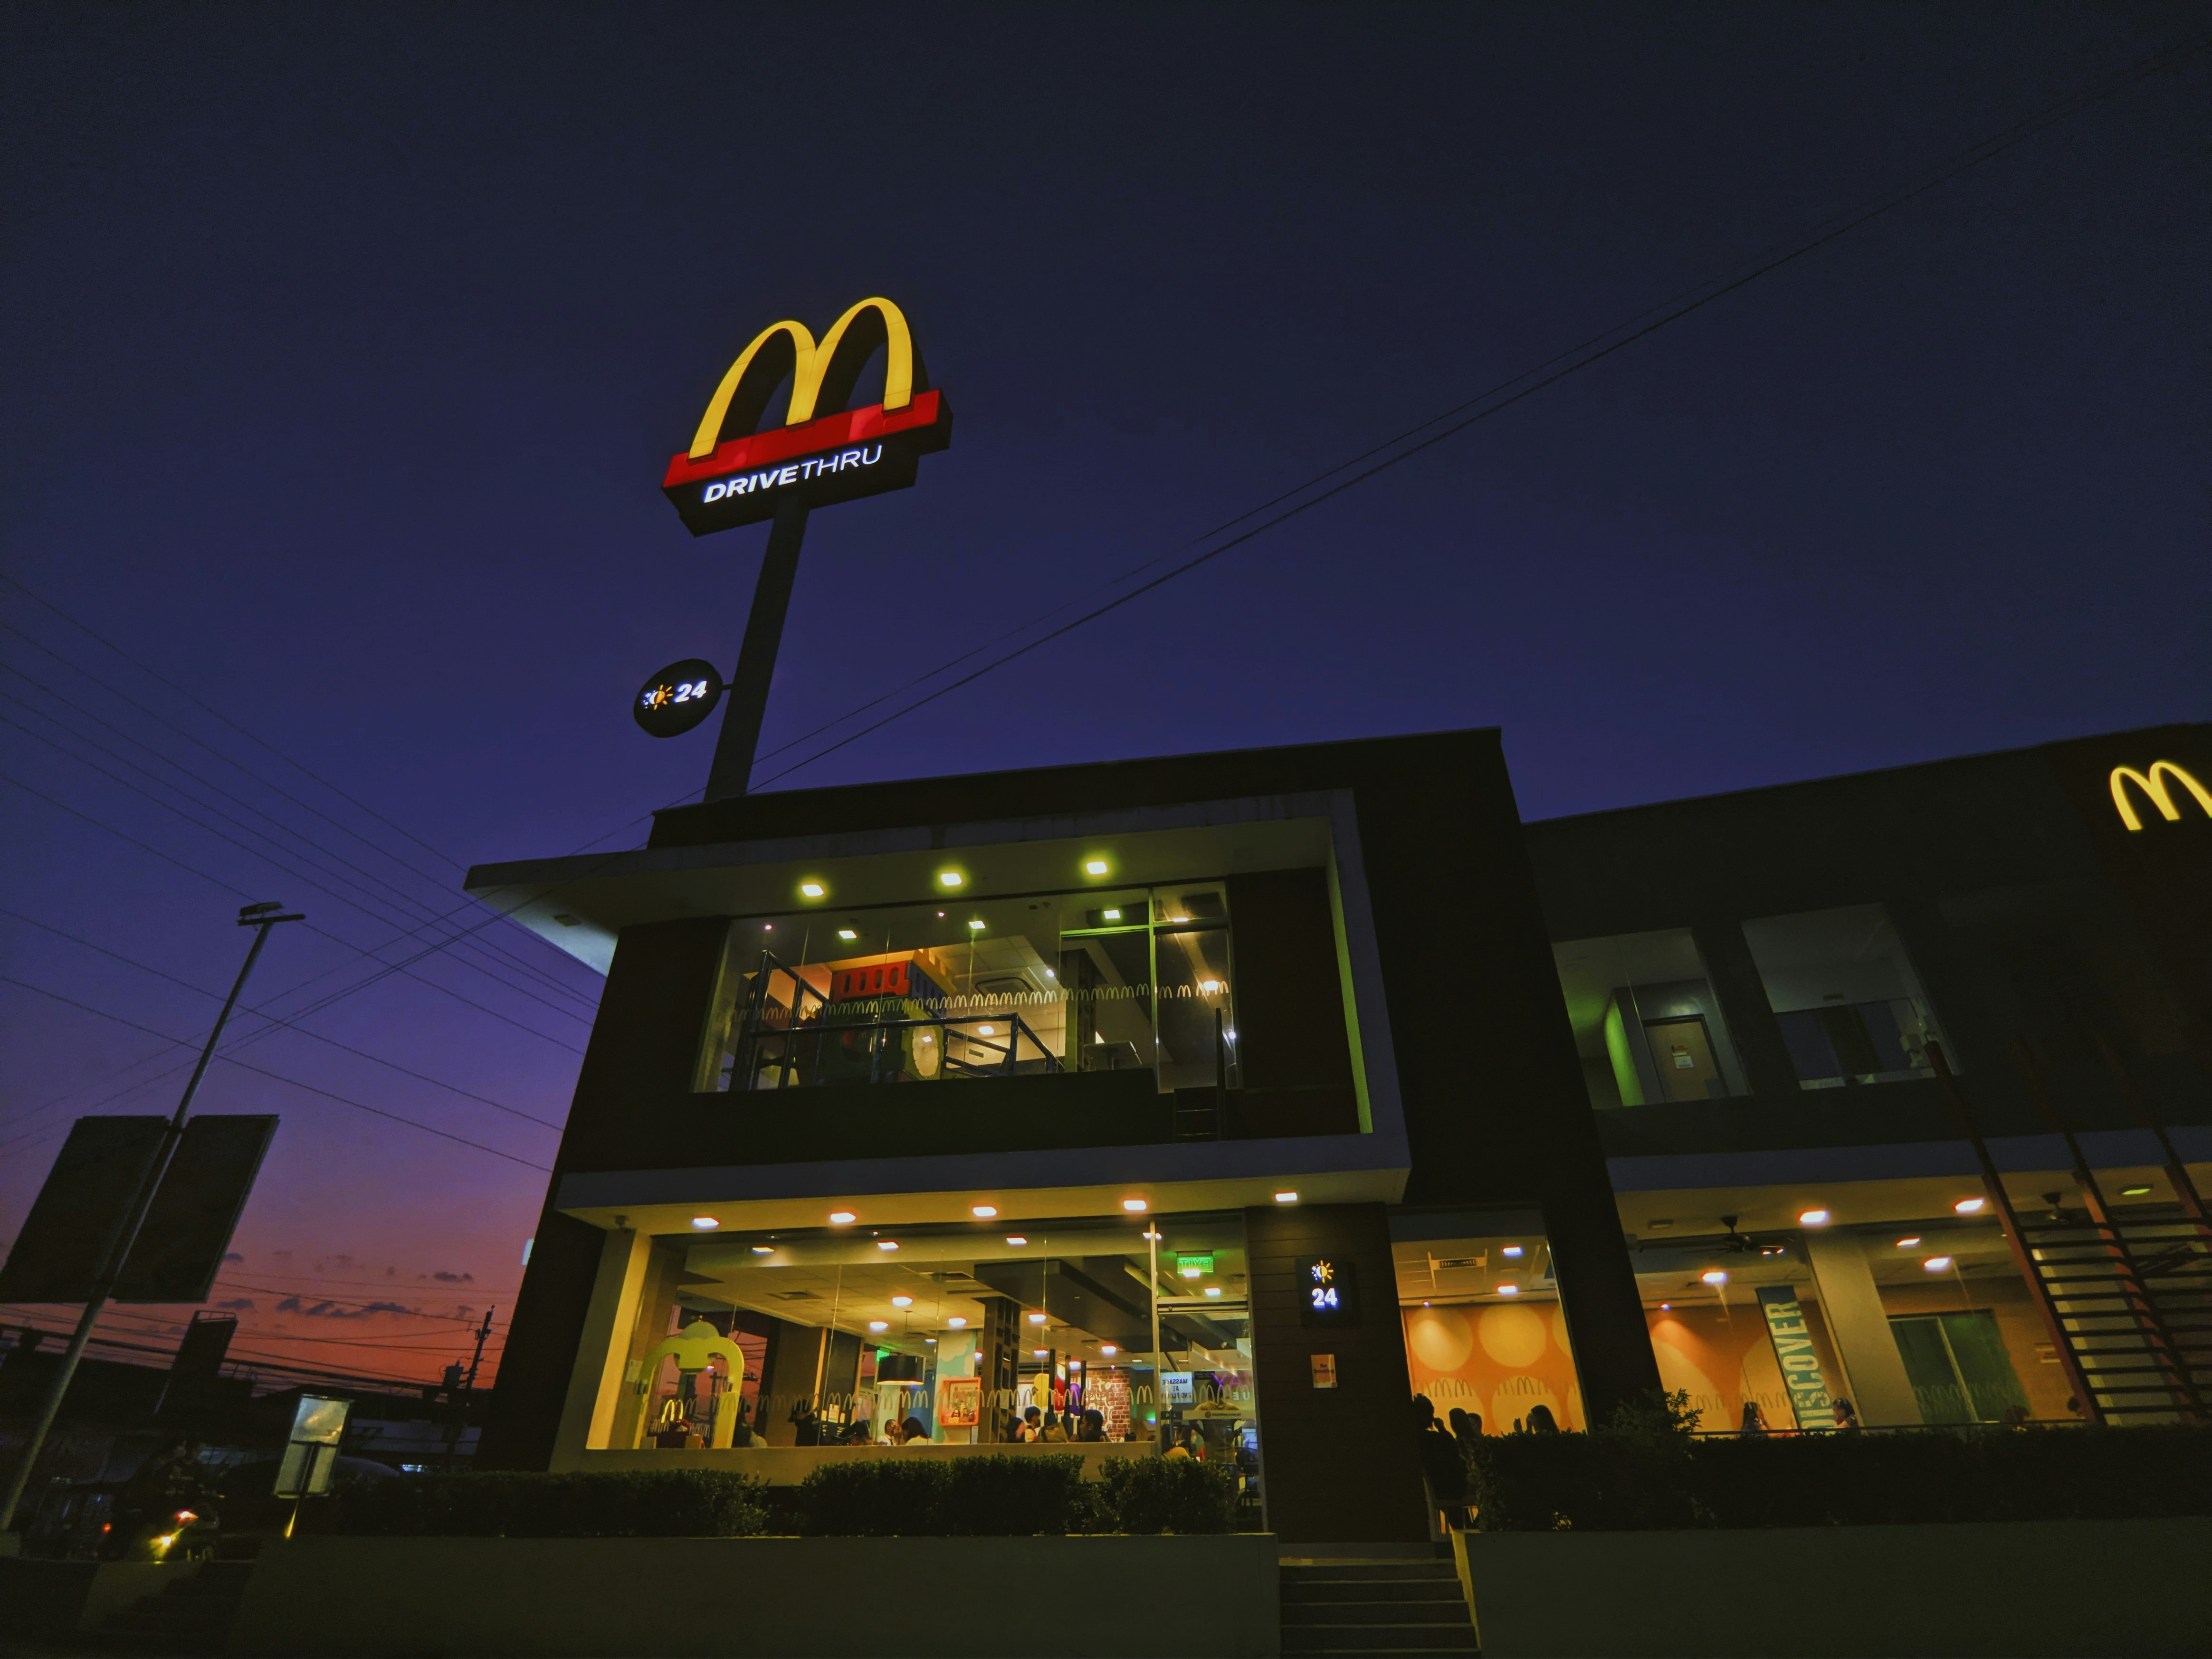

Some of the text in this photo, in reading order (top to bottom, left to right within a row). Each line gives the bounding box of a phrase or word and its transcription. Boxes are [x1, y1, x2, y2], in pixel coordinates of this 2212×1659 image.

[675, 681, 707, 702] 24
[1312, 1288, 1337, 1306] 24
[1766, 1302, 1838, 1434] DISCOVER
